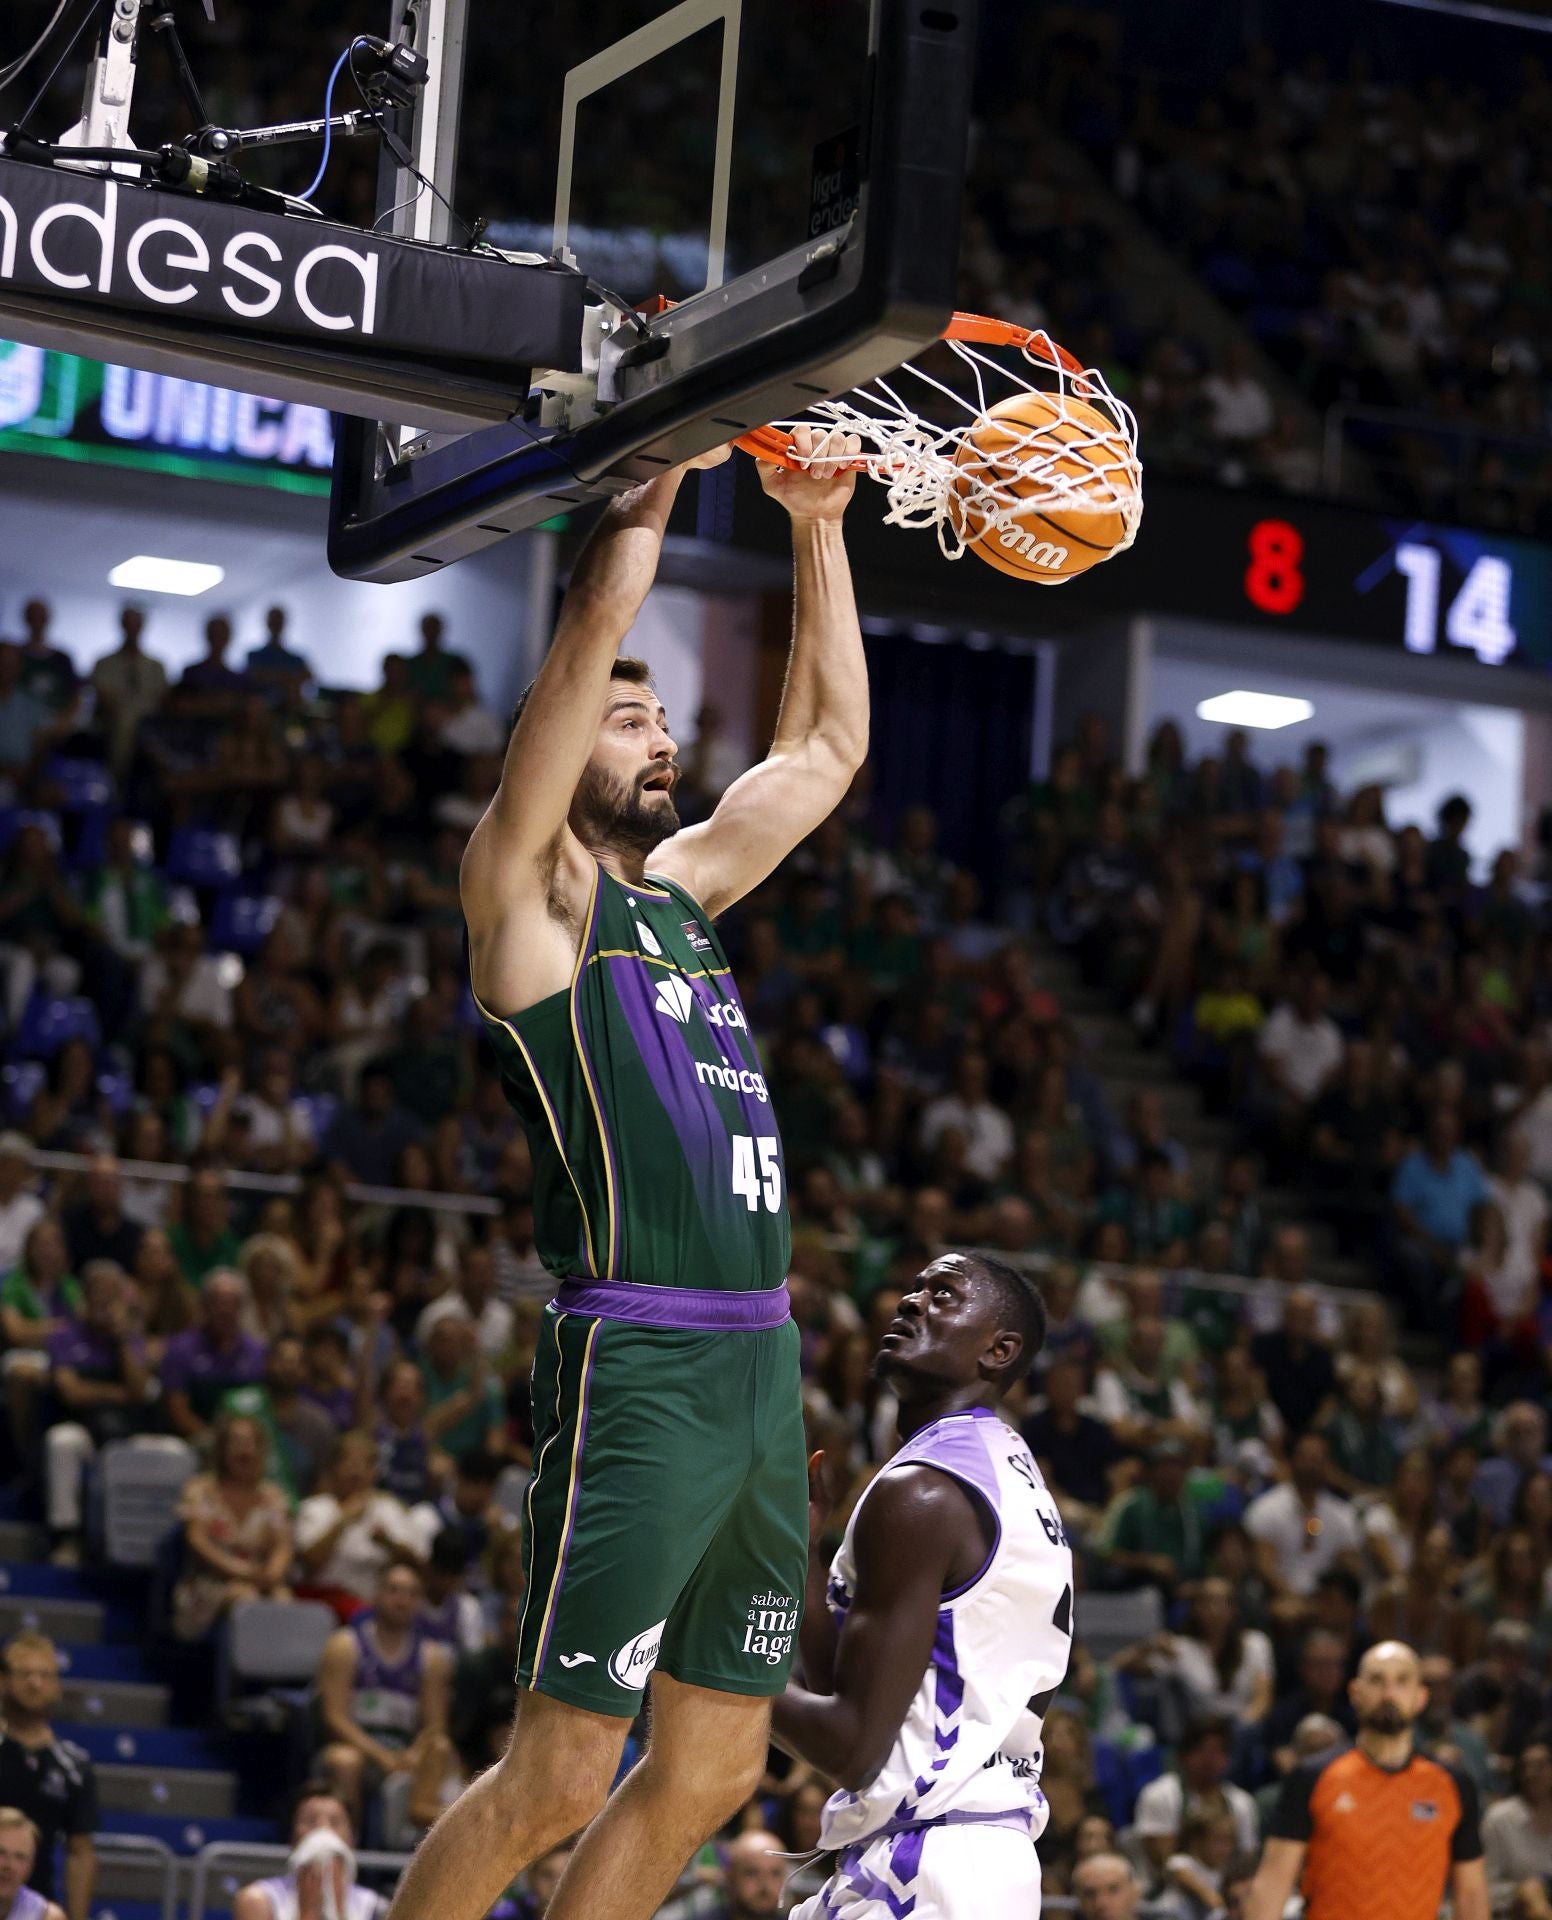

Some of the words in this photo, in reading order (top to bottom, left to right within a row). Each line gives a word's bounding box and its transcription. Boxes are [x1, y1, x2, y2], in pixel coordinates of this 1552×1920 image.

[813, 170, 841, 205] liga
[1245, 518, 1305, 615] 8
[1395, 542, 1516, 665] 14
[732, 1134, 781, 1213] 45
[748, 1609, 756, 1620] a
[756, 1599, 799, 1631] má
[751, 1590, 792, 1607] sabor
[741, 1624, 792, 1665] laga
